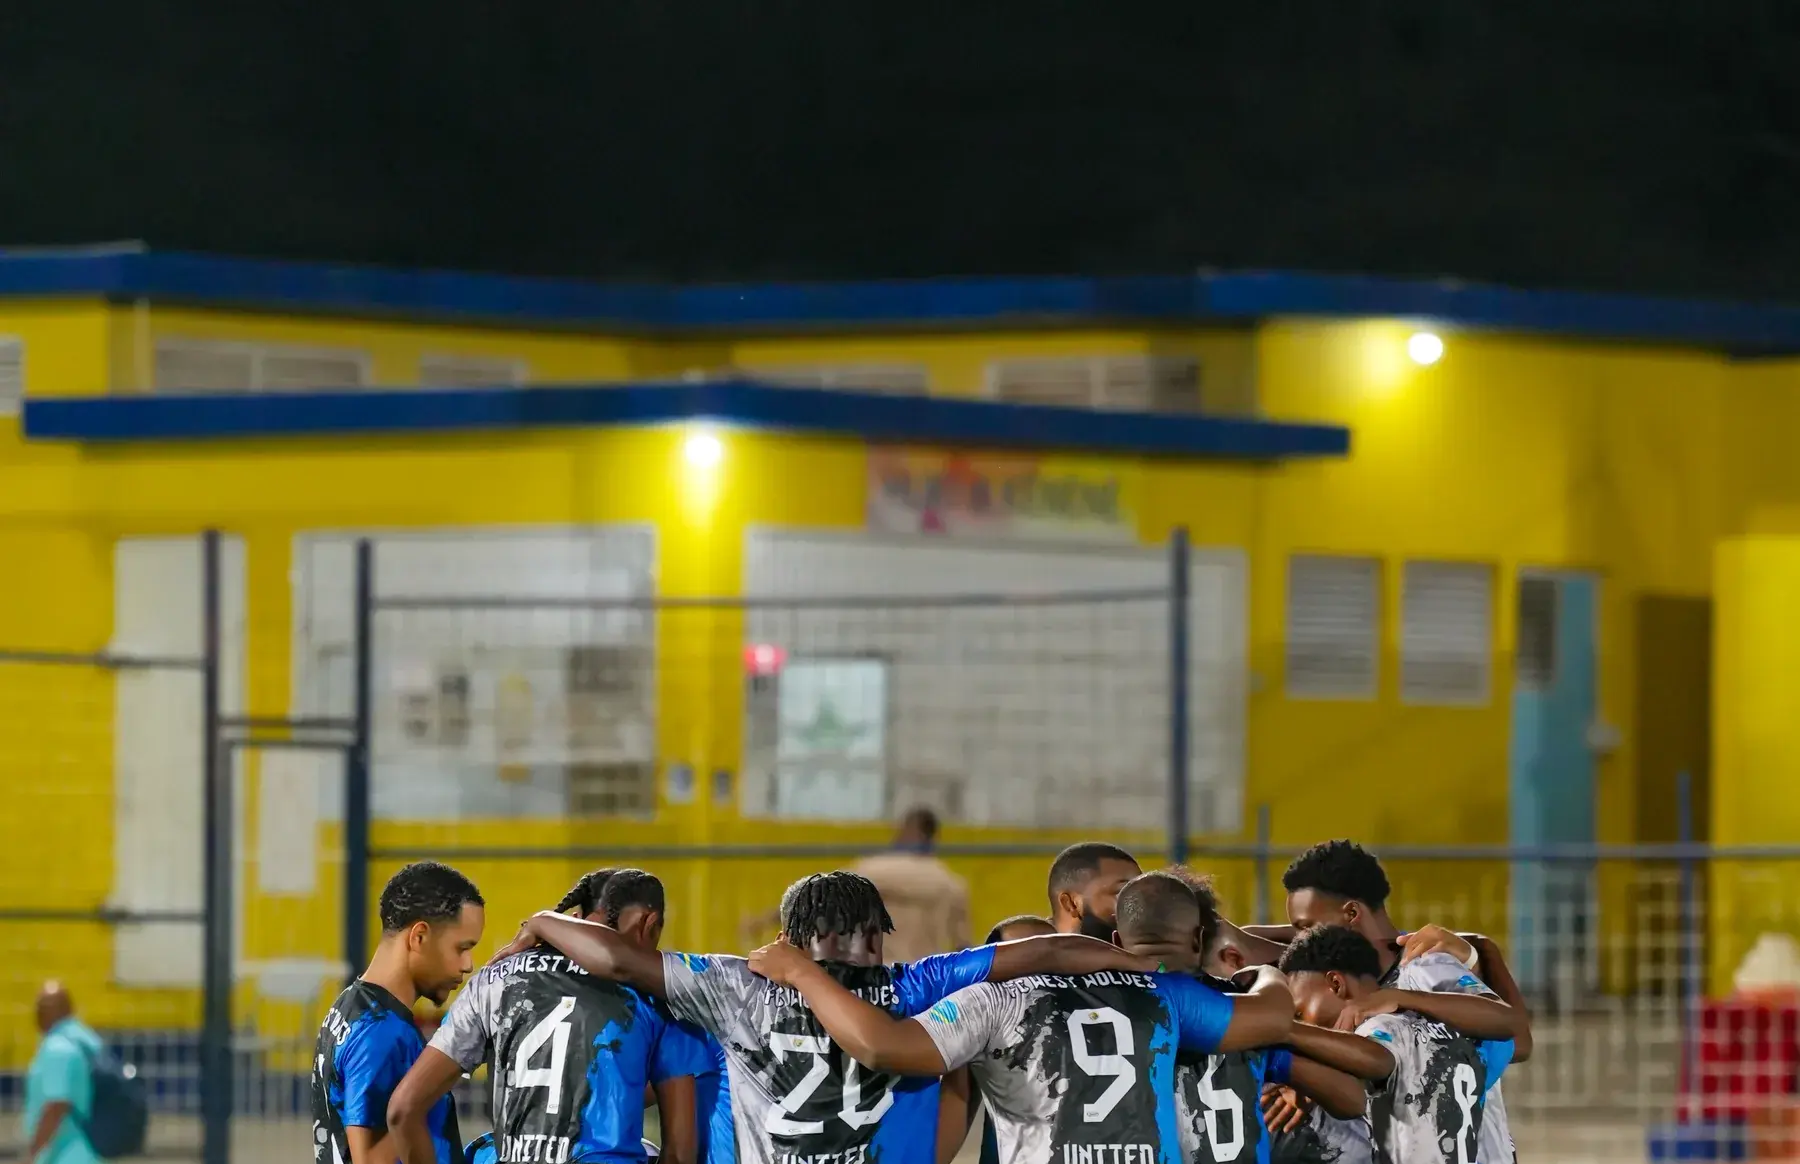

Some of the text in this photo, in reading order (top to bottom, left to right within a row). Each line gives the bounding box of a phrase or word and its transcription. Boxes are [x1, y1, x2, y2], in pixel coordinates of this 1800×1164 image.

[488, 961, 511, 985] FC
[513, 955, 564, 973] WEST
[1029, 974, 1078, 989] WEST
[1080, 971, 1158, 989] WOLVES
[515, 996, 576, 1115] 4
[1066, 1006, 1135, 1123] 9
[1197, 1054, 1244, 1163] 6
[499, 1133, 570, 1164] UNITED
